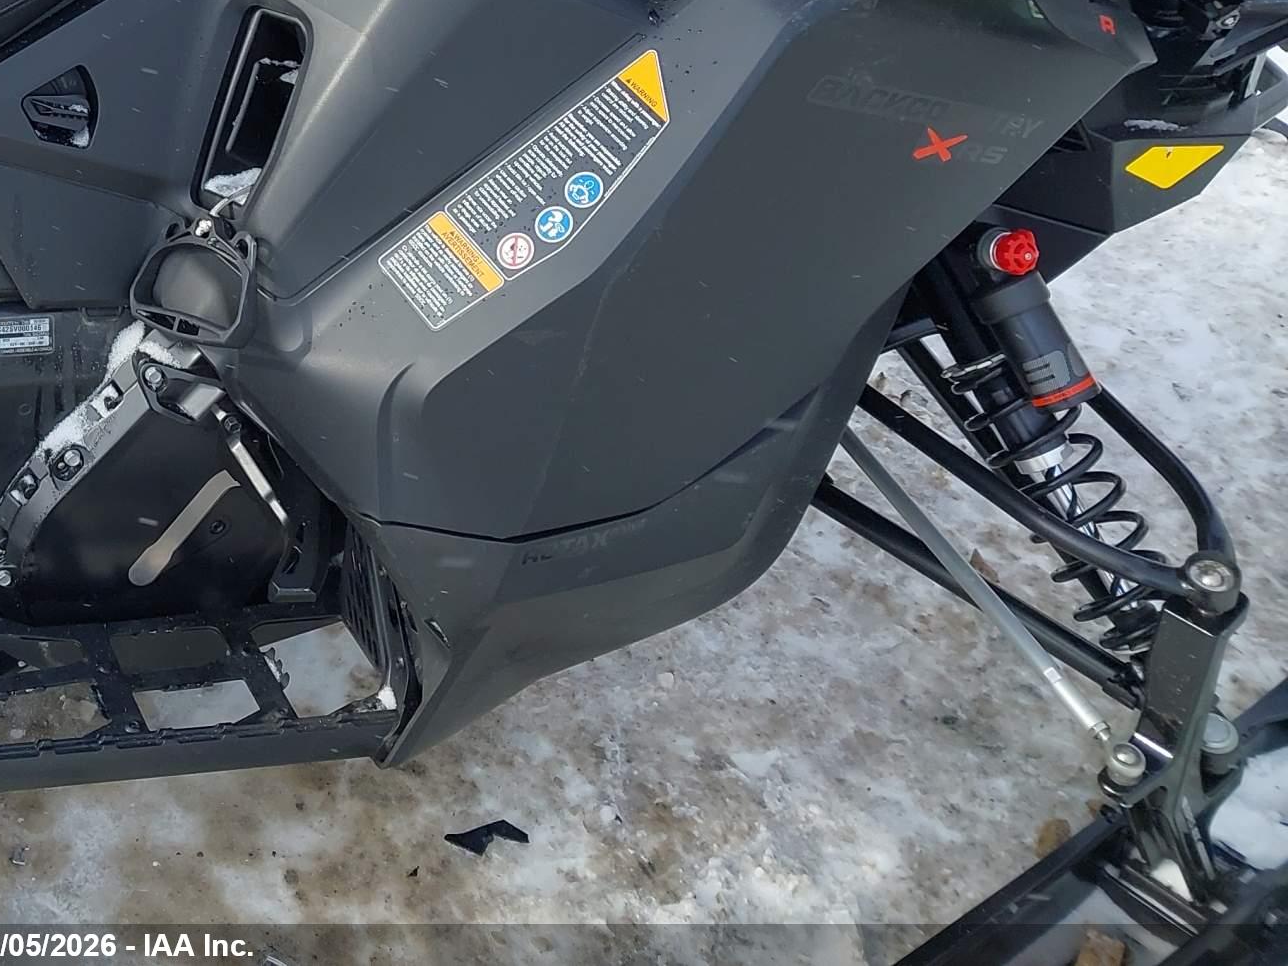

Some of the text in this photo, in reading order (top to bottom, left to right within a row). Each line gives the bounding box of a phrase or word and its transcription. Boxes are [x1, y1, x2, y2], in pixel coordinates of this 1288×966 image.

[631, 81, 658, 107] WARNING
[441, 232, 485, 277] AVERTISSEMENT
[454, 234, 479, 262] WARNING
